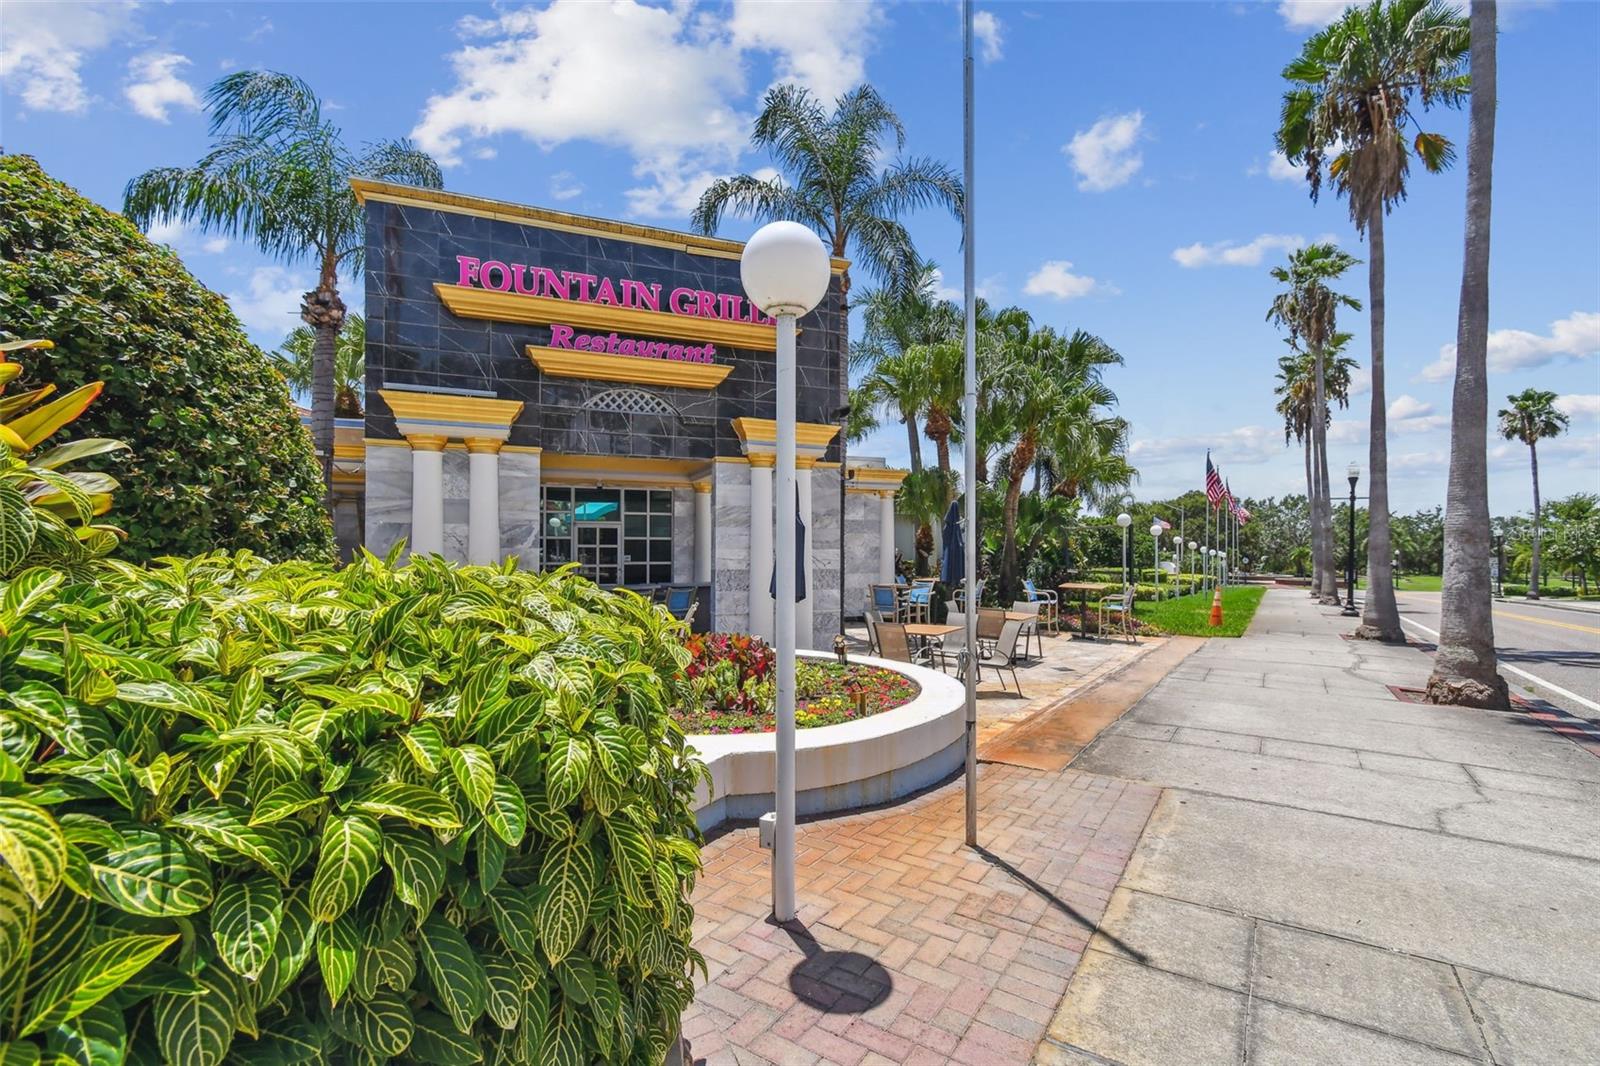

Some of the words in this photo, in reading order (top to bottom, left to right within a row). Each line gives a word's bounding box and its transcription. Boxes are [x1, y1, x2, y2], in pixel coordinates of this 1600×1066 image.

[456, 254, 662, 312] FOUNTAIN
[669, 287, 777, 326] GRILL
[548, 325, 715, 364] Restaurant
